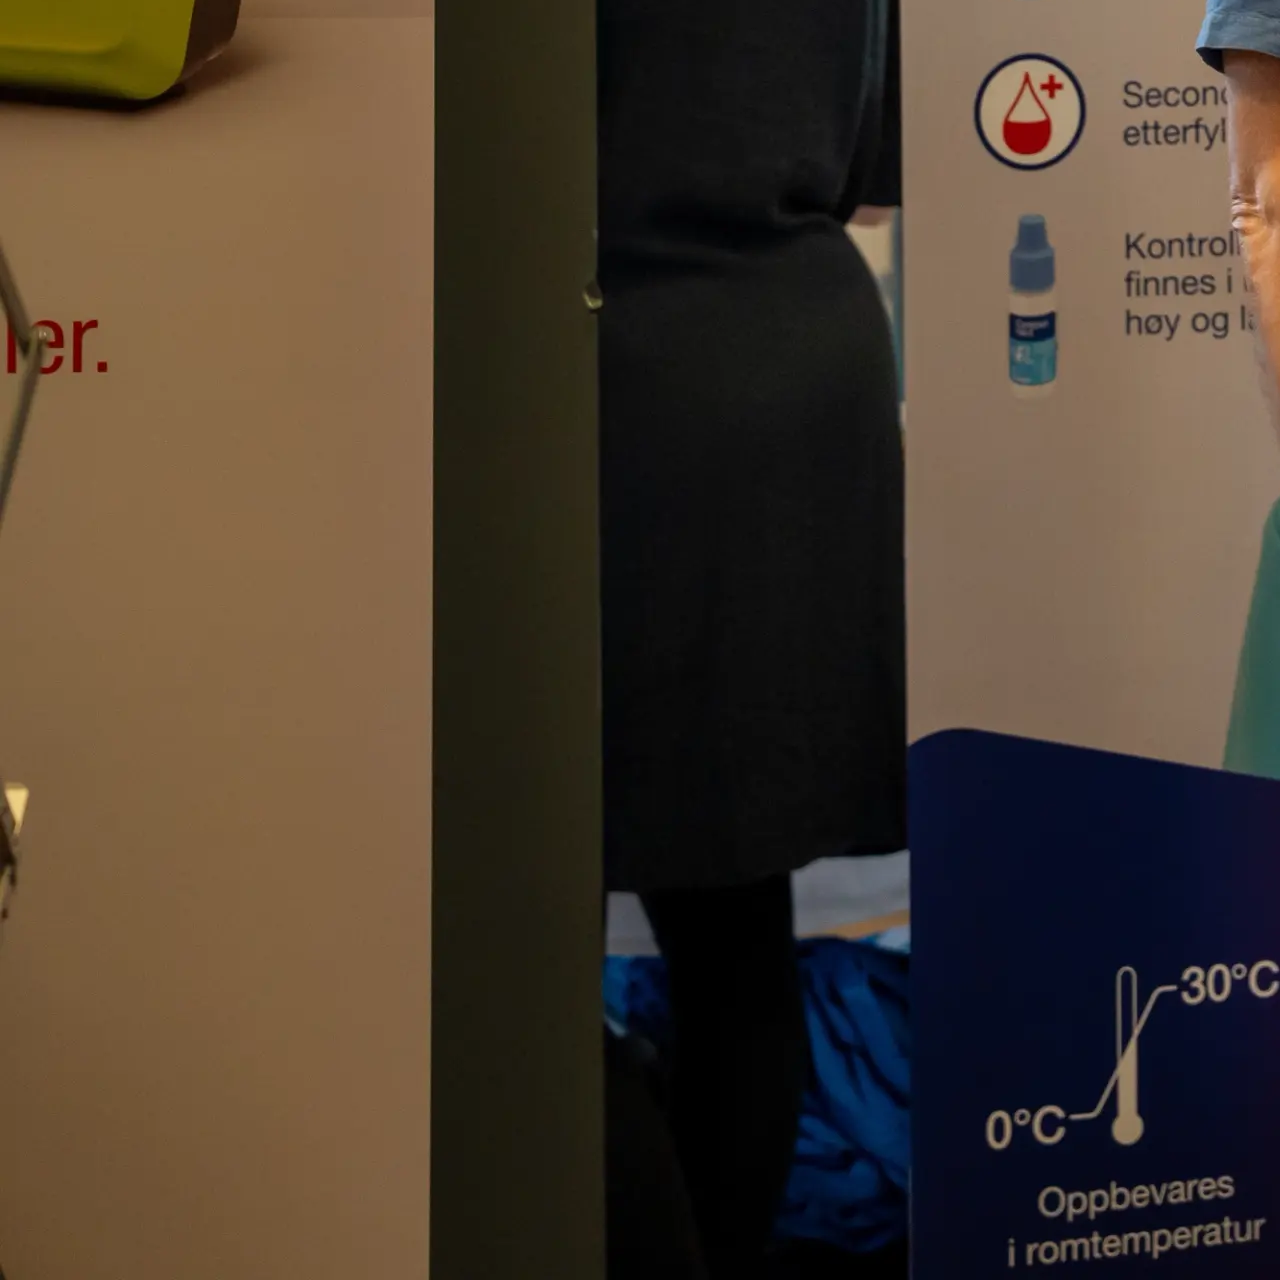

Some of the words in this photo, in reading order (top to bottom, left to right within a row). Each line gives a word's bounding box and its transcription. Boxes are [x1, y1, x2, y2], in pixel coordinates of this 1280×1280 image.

[1124, 269, 1217, 297] finnes
[1226, 268, 1233, 294] i
[1125, 309, 1181, 342] høy
[1191, 311, 1229, 339] og
[1180, 959, 1280, 1005] 30°C
[986, 1105, 1067, 1150] 0°C
[1037, 1174, 1235, 1222] Oppbevares
[1007, 1237, 1016, 1268] i
[1026, 1216, 1267, 1266] romtemperatur
